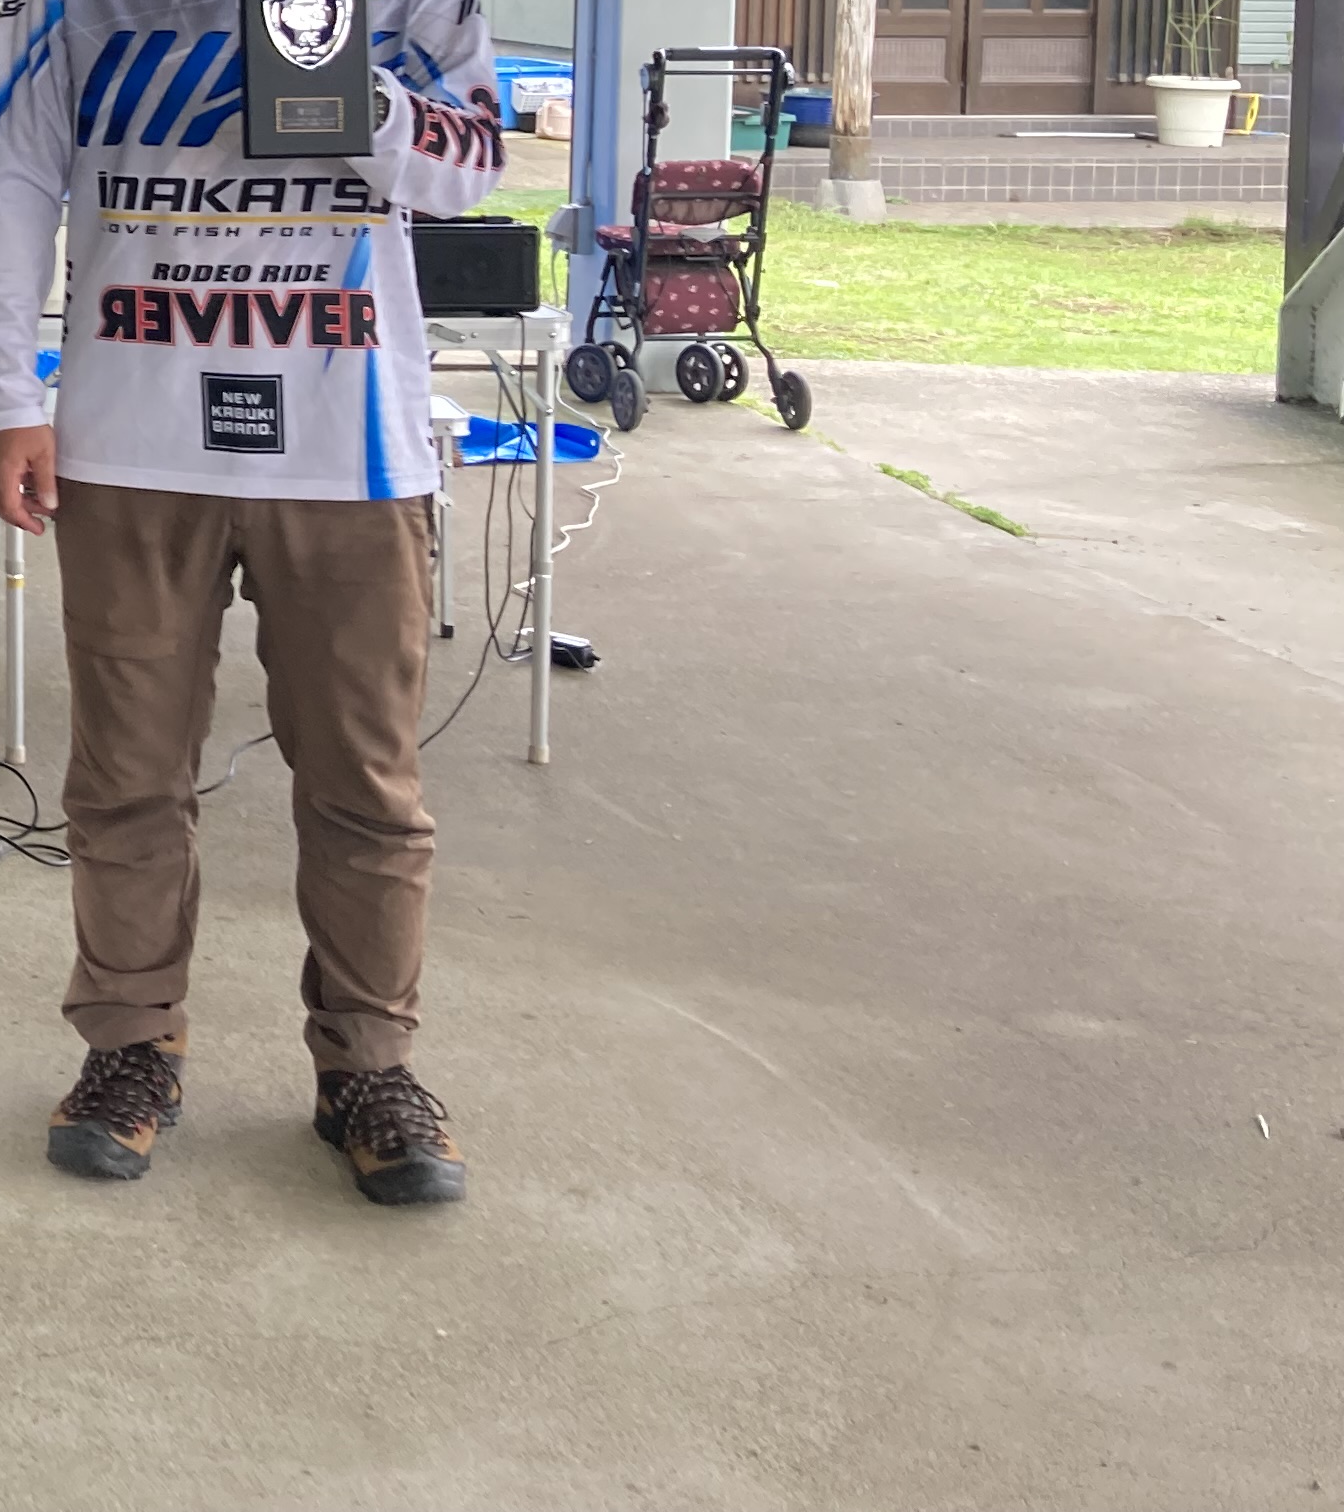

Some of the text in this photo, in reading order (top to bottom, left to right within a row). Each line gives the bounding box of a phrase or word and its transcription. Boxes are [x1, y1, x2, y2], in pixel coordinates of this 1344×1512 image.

[173, 226, 240, 237] FISH
[259, 226, 313, 237] FOR
[152, 263, 331, 283] RODEO RIDE
[222, 391, 262, 405] NEW
[211, 405, 275, 420] KABUKI
